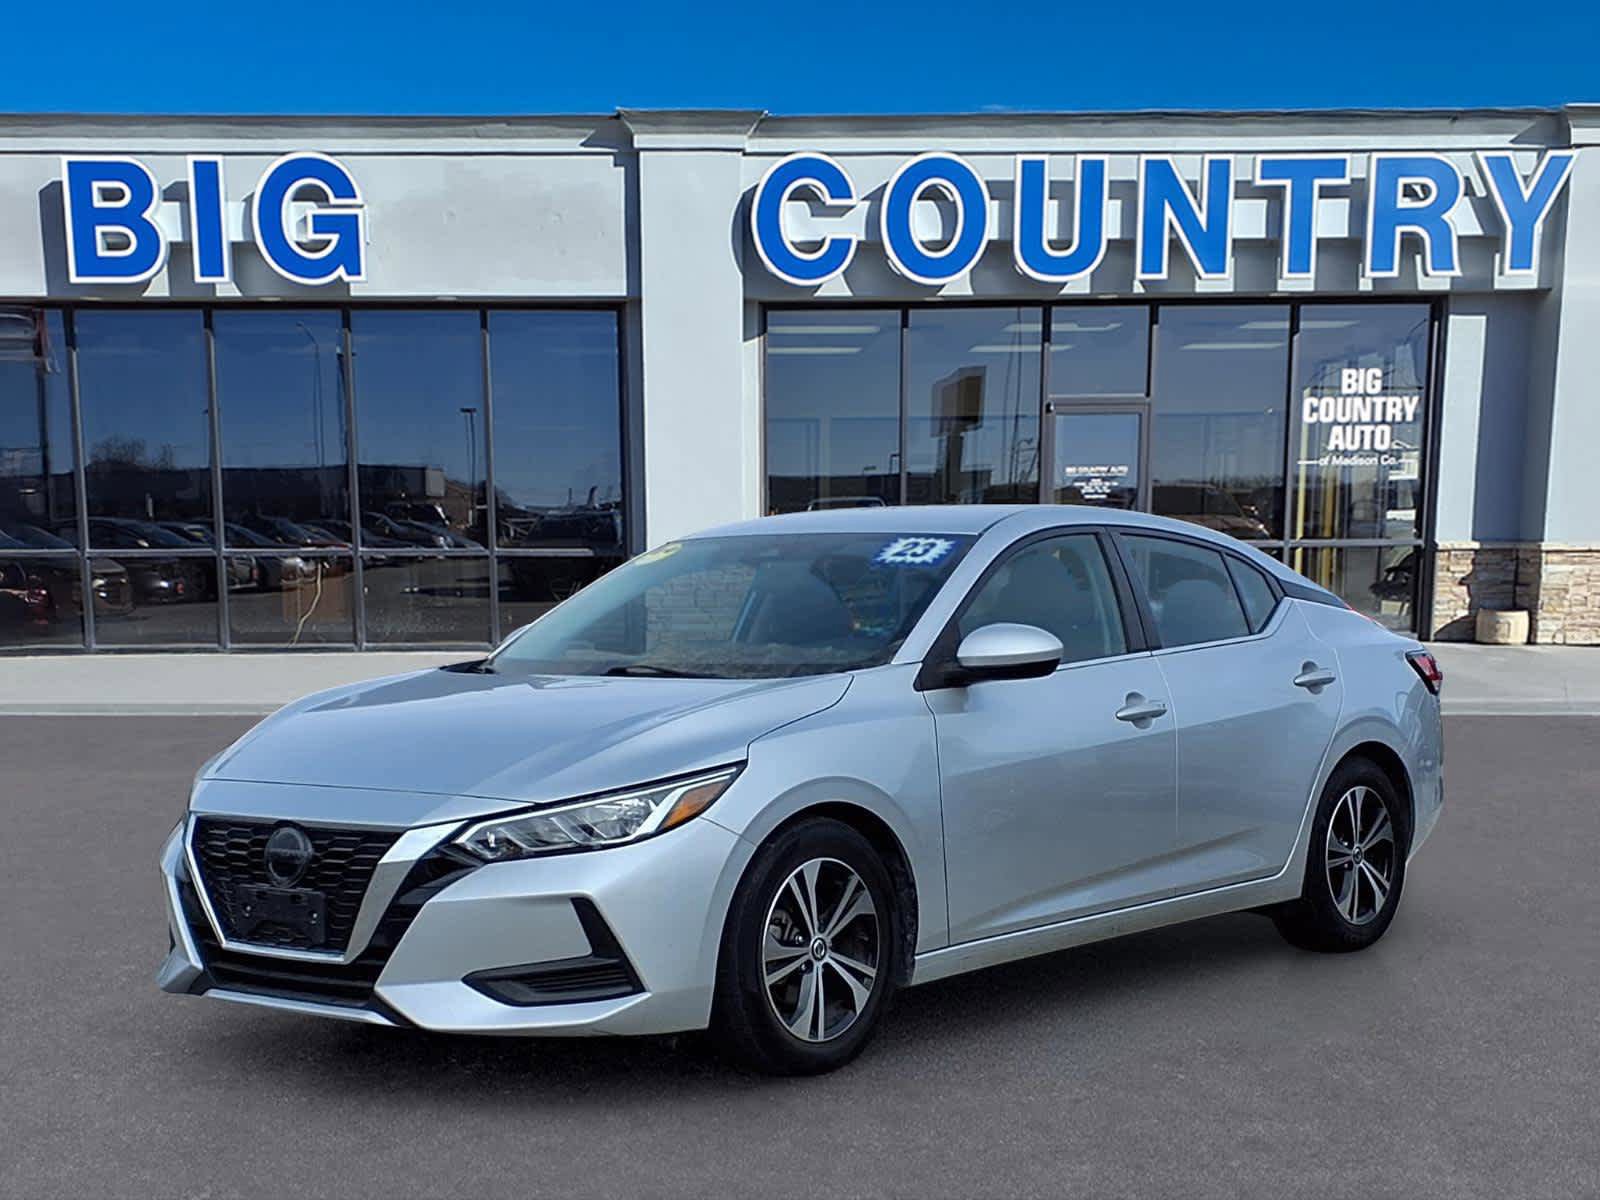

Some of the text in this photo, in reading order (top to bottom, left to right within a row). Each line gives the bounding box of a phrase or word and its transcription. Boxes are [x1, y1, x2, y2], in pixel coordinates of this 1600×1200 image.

[61, 152, 1580, 286] BIG COUNTRY
[1341, 368, 1382, 394] BIG
[1303, 396, 1419, 423] COUNTRY
[1327, 425, 1392, 450] AUTO
[1320, 454, 1399, 465] of Madison Co.
[890, 541, 937, 558] 23
